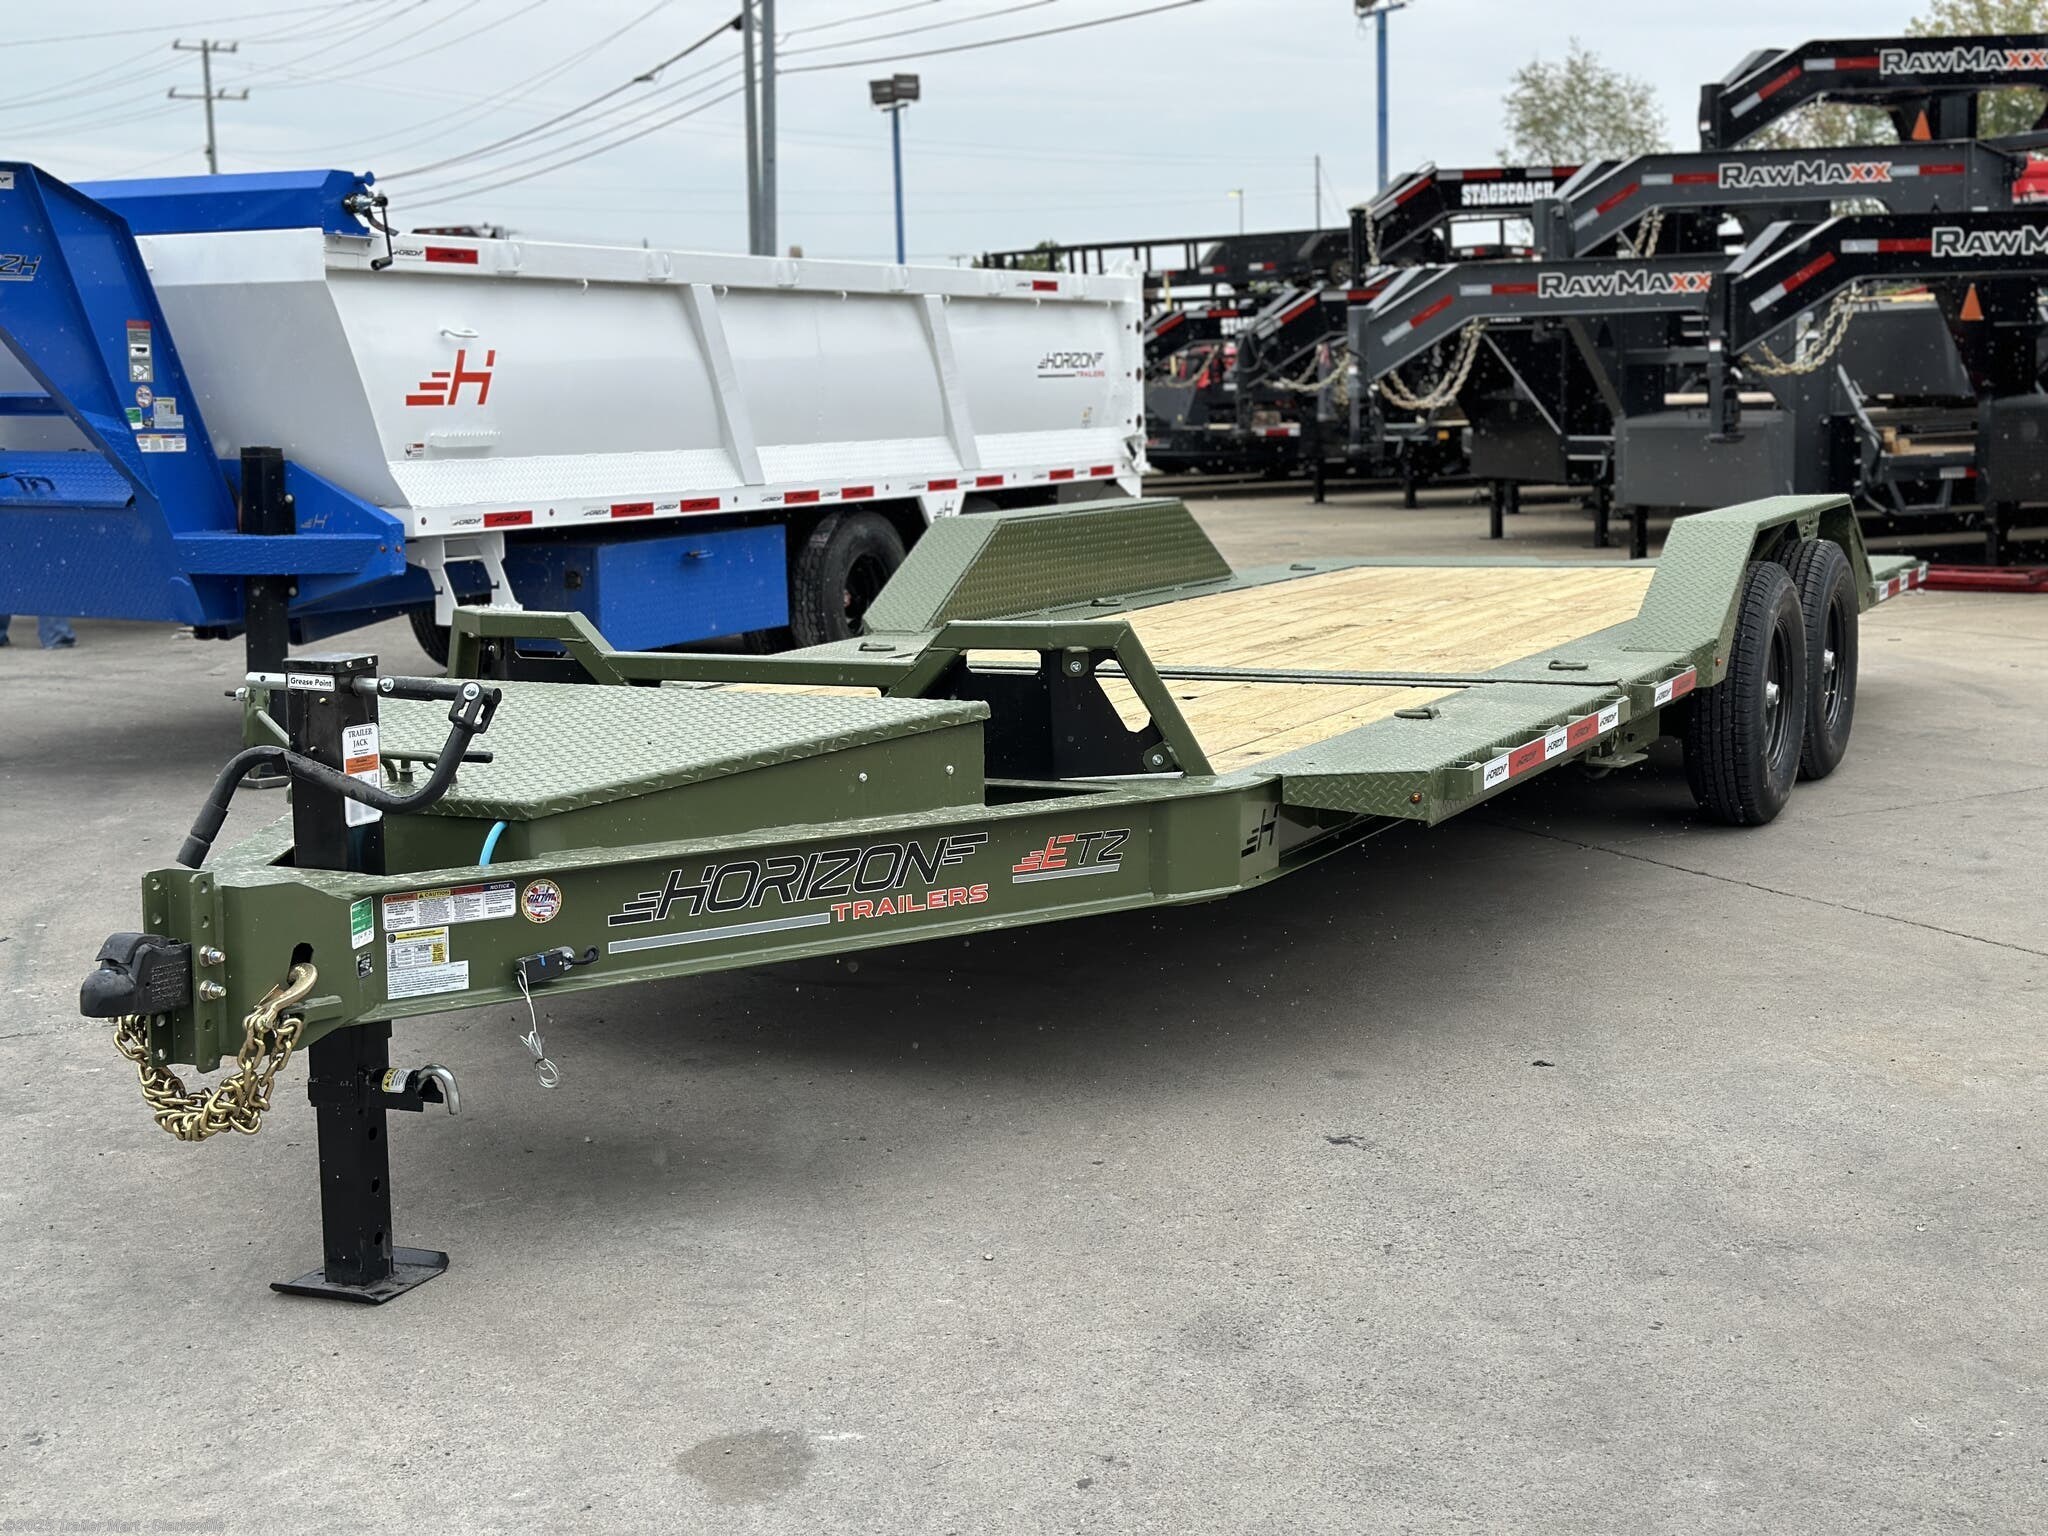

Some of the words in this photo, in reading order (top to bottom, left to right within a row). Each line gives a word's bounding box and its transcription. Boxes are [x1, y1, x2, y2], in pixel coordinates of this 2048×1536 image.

[1461, 181, 1555, 206] STAGECOACH
[1044, 352, 1099, 369] HORIZON
[290, 677, 313, 686] Grease
[314, 679, 332, 688] Point
[348, 727, 373, 739] TRAILER
[353, 738, 369, 749] JACK
[650, 837, 950, 921] HORIZON
[424, 890, 450, 899] CAUTION
[831, 884, 989, 922] TRAILERS
